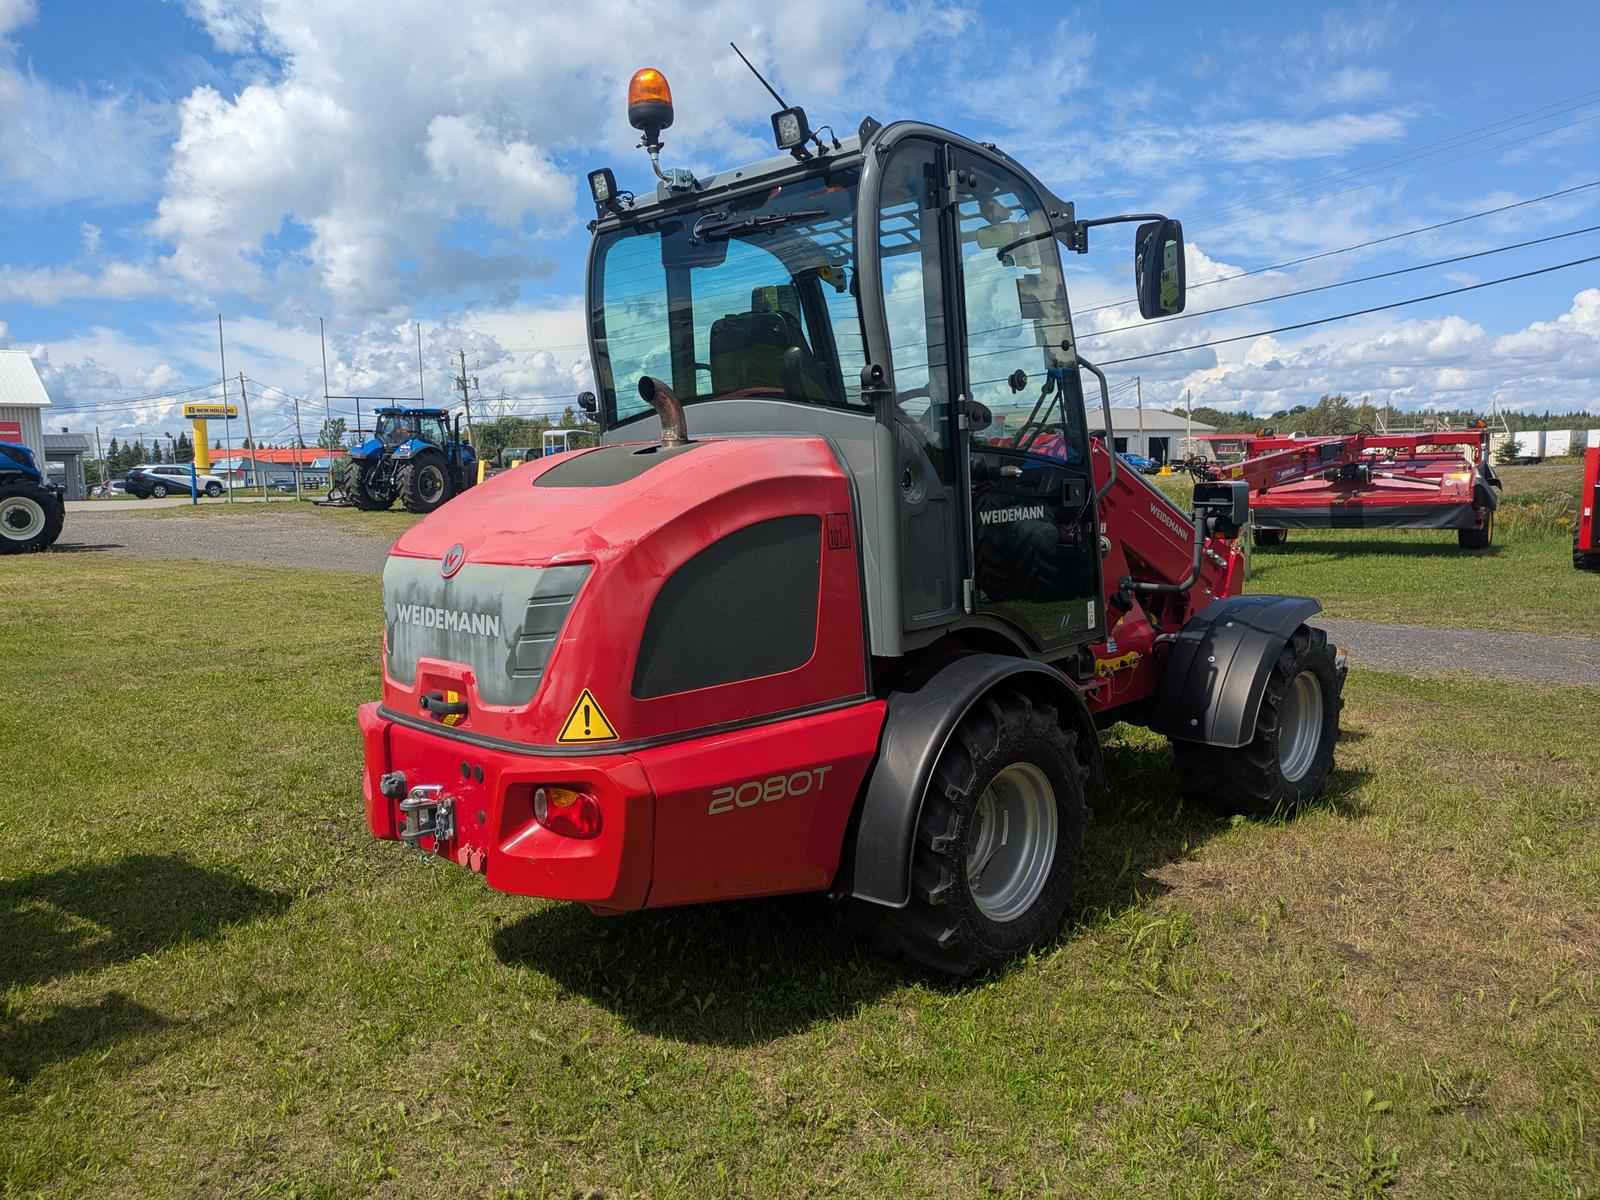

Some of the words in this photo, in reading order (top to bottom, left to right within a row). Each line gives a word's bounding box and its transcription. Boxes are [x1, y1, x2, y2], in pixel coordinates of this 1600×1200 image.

[979, 505, 1044, 526] WEIDEMANN
[1150, 502, 1188, 541] WEIDEMANN
[396, 603, 500, 637] WEIDEMANN
[708, 765, 832, 815] 2080T
